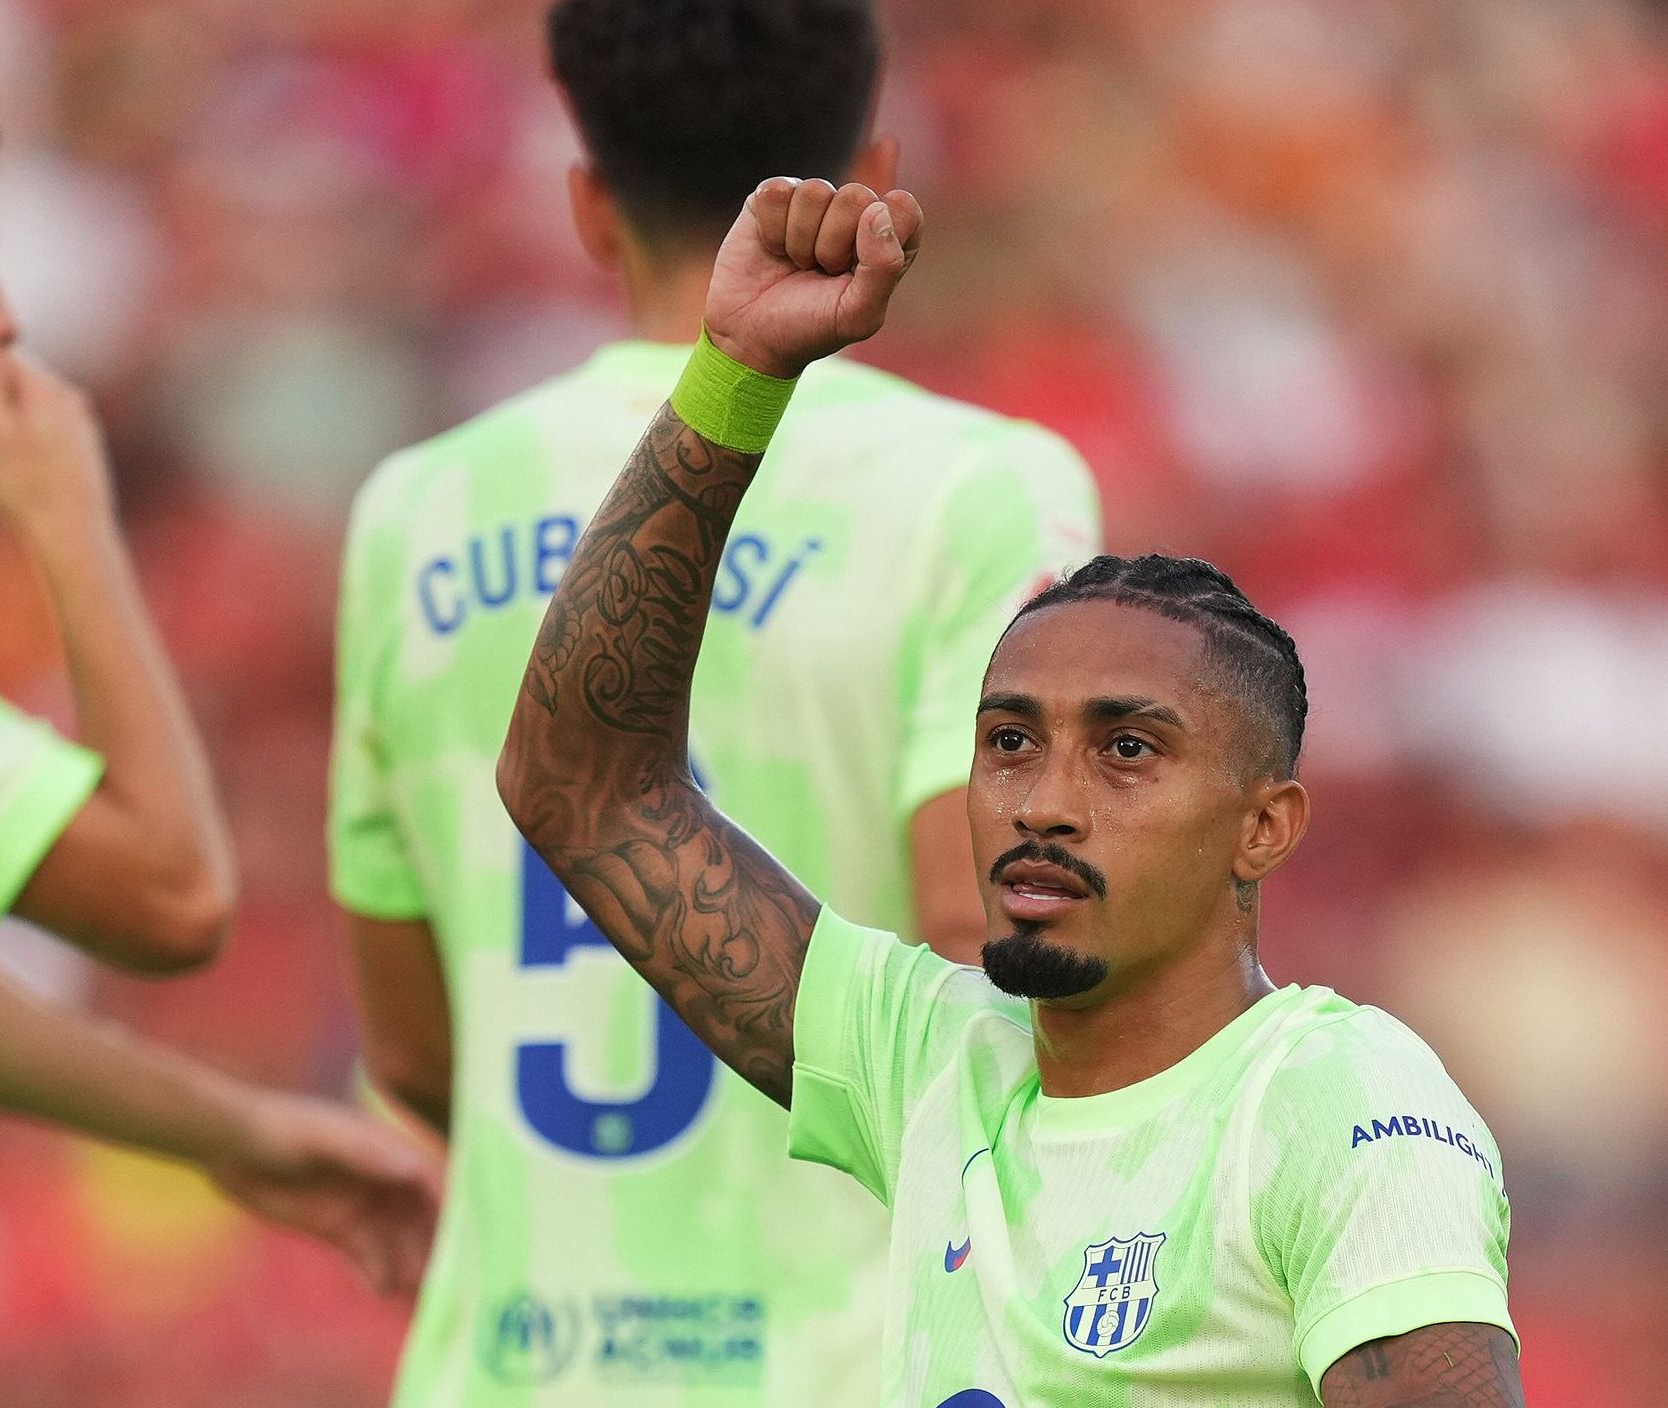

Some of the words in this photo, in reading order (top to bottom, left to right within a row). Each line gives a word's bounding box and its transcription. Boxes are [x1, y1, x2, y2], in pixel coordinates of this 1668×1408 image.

[416, 515, 822, 636] CUBSÍ
[515, 757, 717, 1159] 5
[1097, 1285, 1131, 1303] FCB
